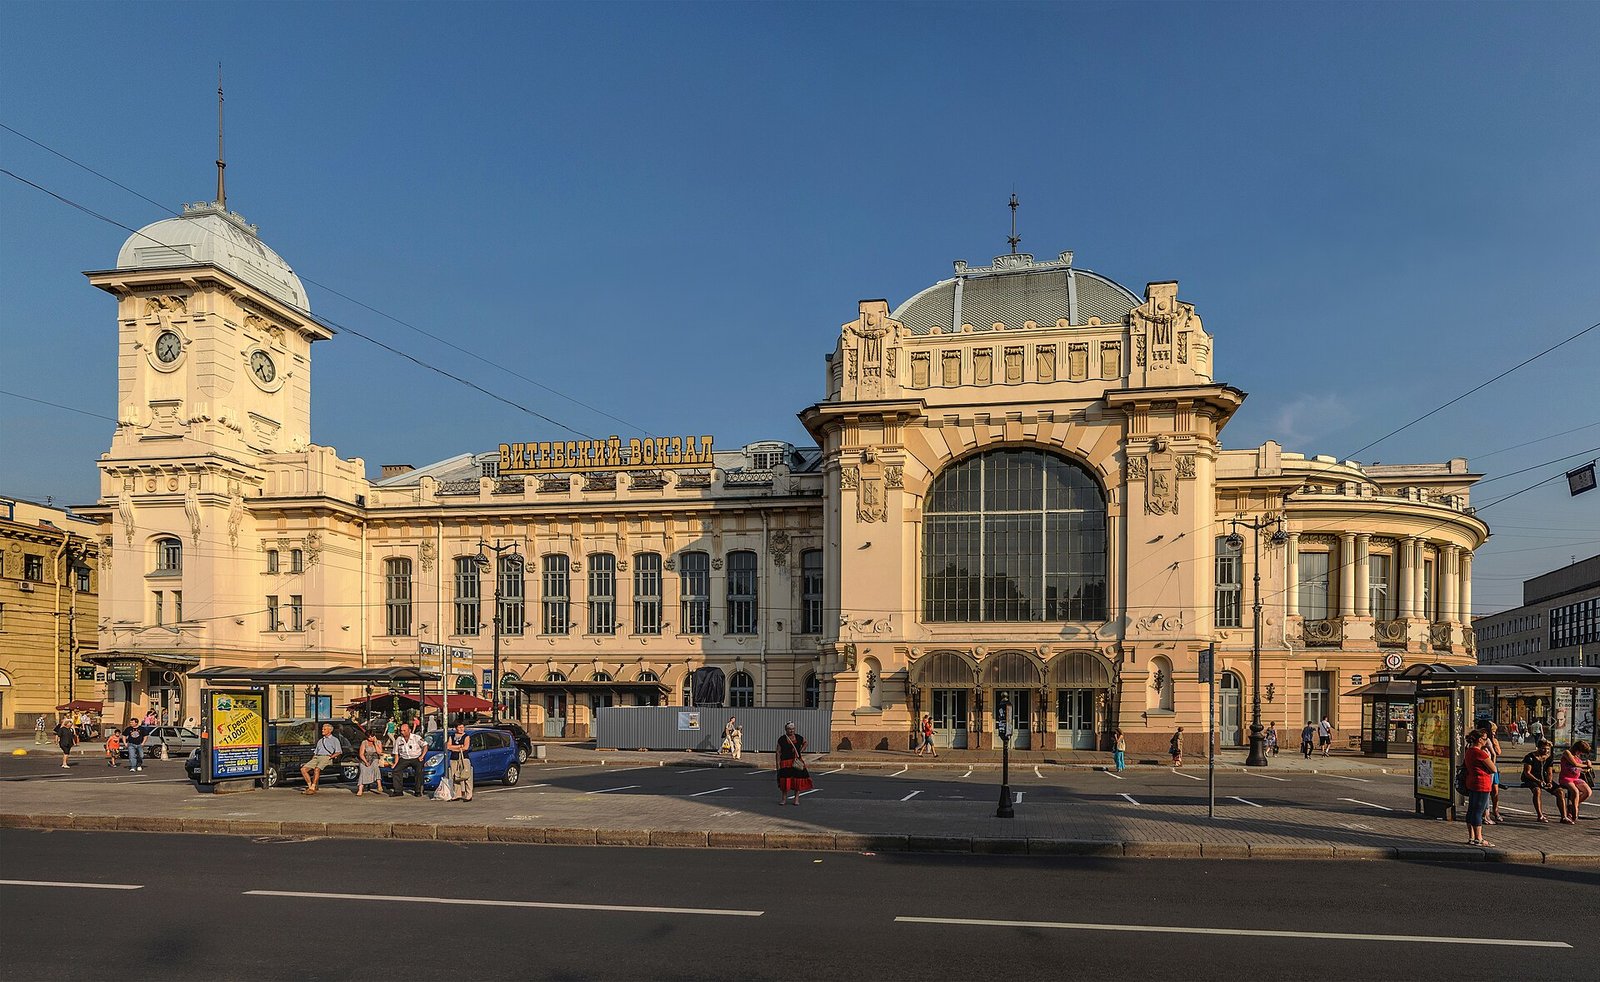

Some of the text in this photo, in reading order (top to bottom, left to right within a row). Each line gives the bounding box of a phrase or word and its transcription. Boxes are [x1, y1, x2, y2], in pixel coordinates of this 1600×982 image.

[499, 435, 713, 469] ВИТЕБСКИЙ ВОКЗАЛ
[1418, 700, 1449, 714] ОТЕЛИ
[227, 712, 254, 732] Греция
